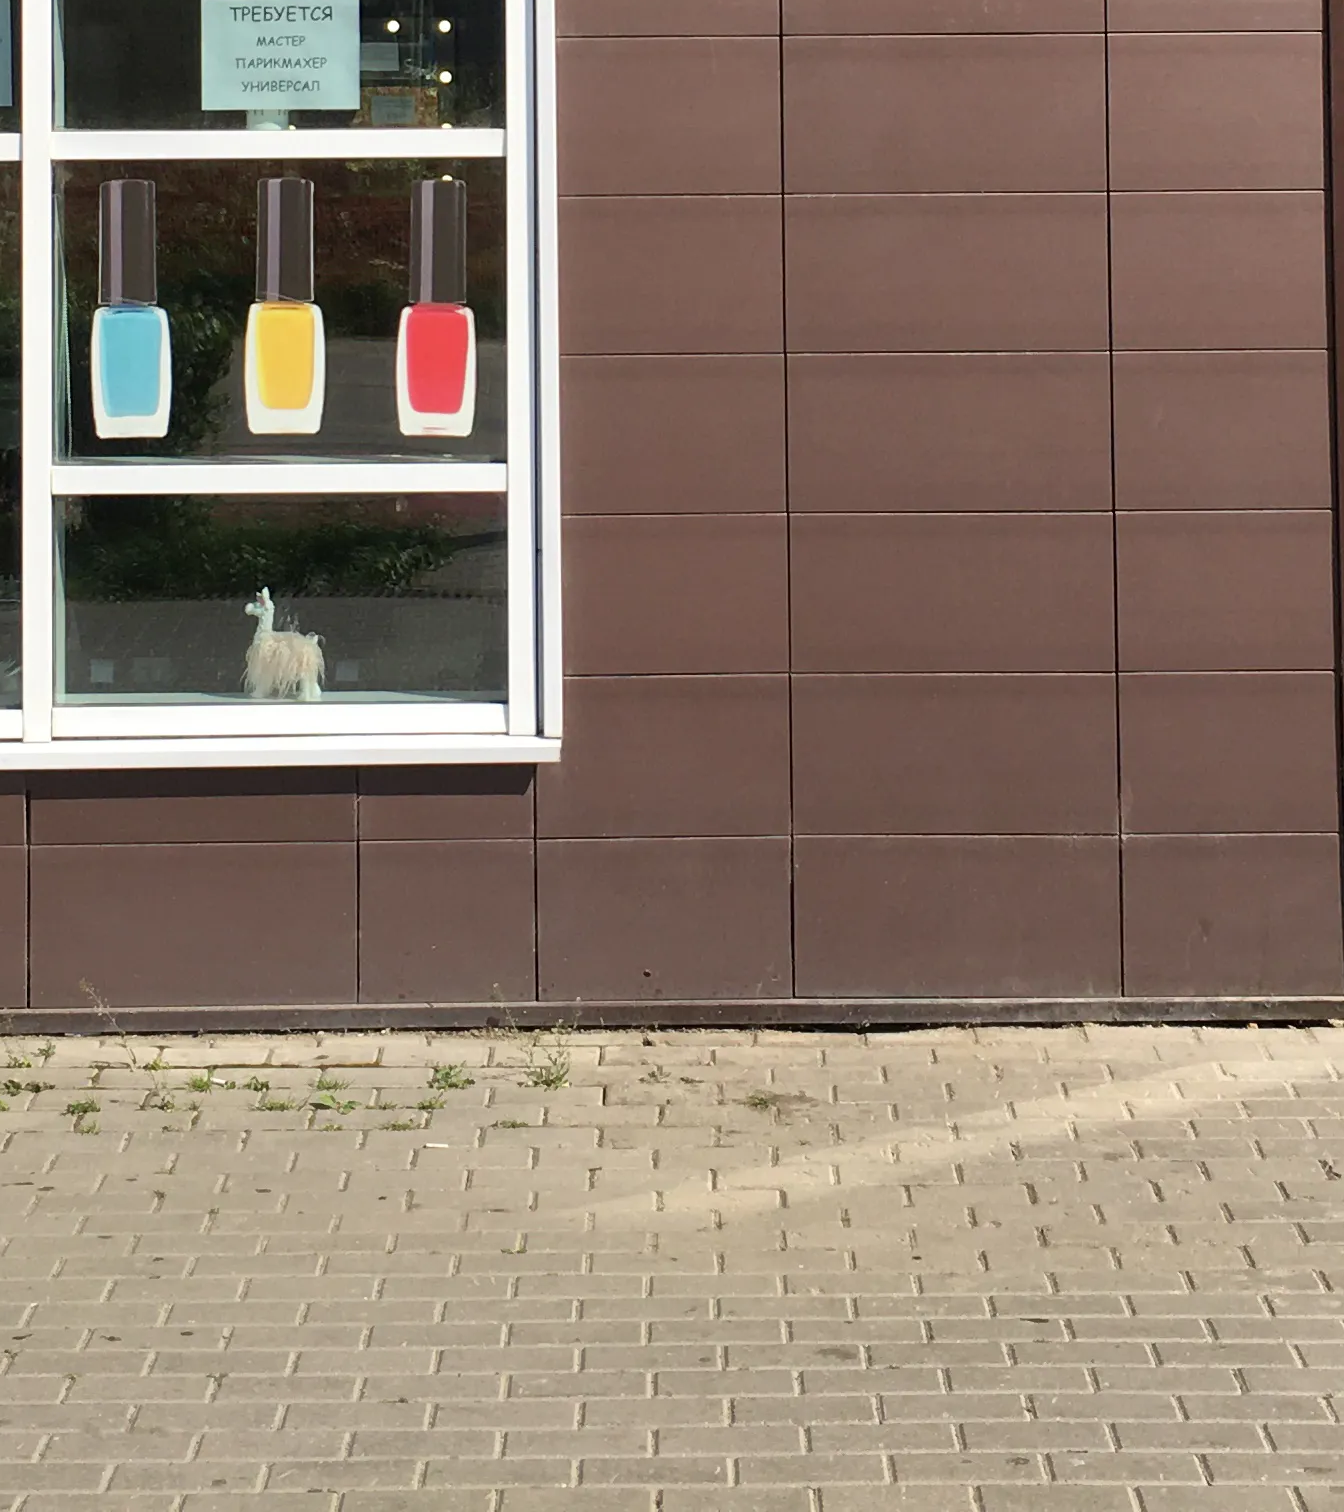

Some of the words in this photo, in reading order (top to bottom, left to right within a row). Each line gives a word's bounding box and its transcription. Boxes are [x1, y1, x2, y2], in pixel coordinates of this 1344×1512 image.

[229, 6, 333, 23] ТРЕБУЕТСЯ
[256, 35, 306, 48] МАСТЕР
[235, 57, 327, 70] ПАРИКМАХЕР
[241, 80, 321, 93] УНИВЕРСАЛ
